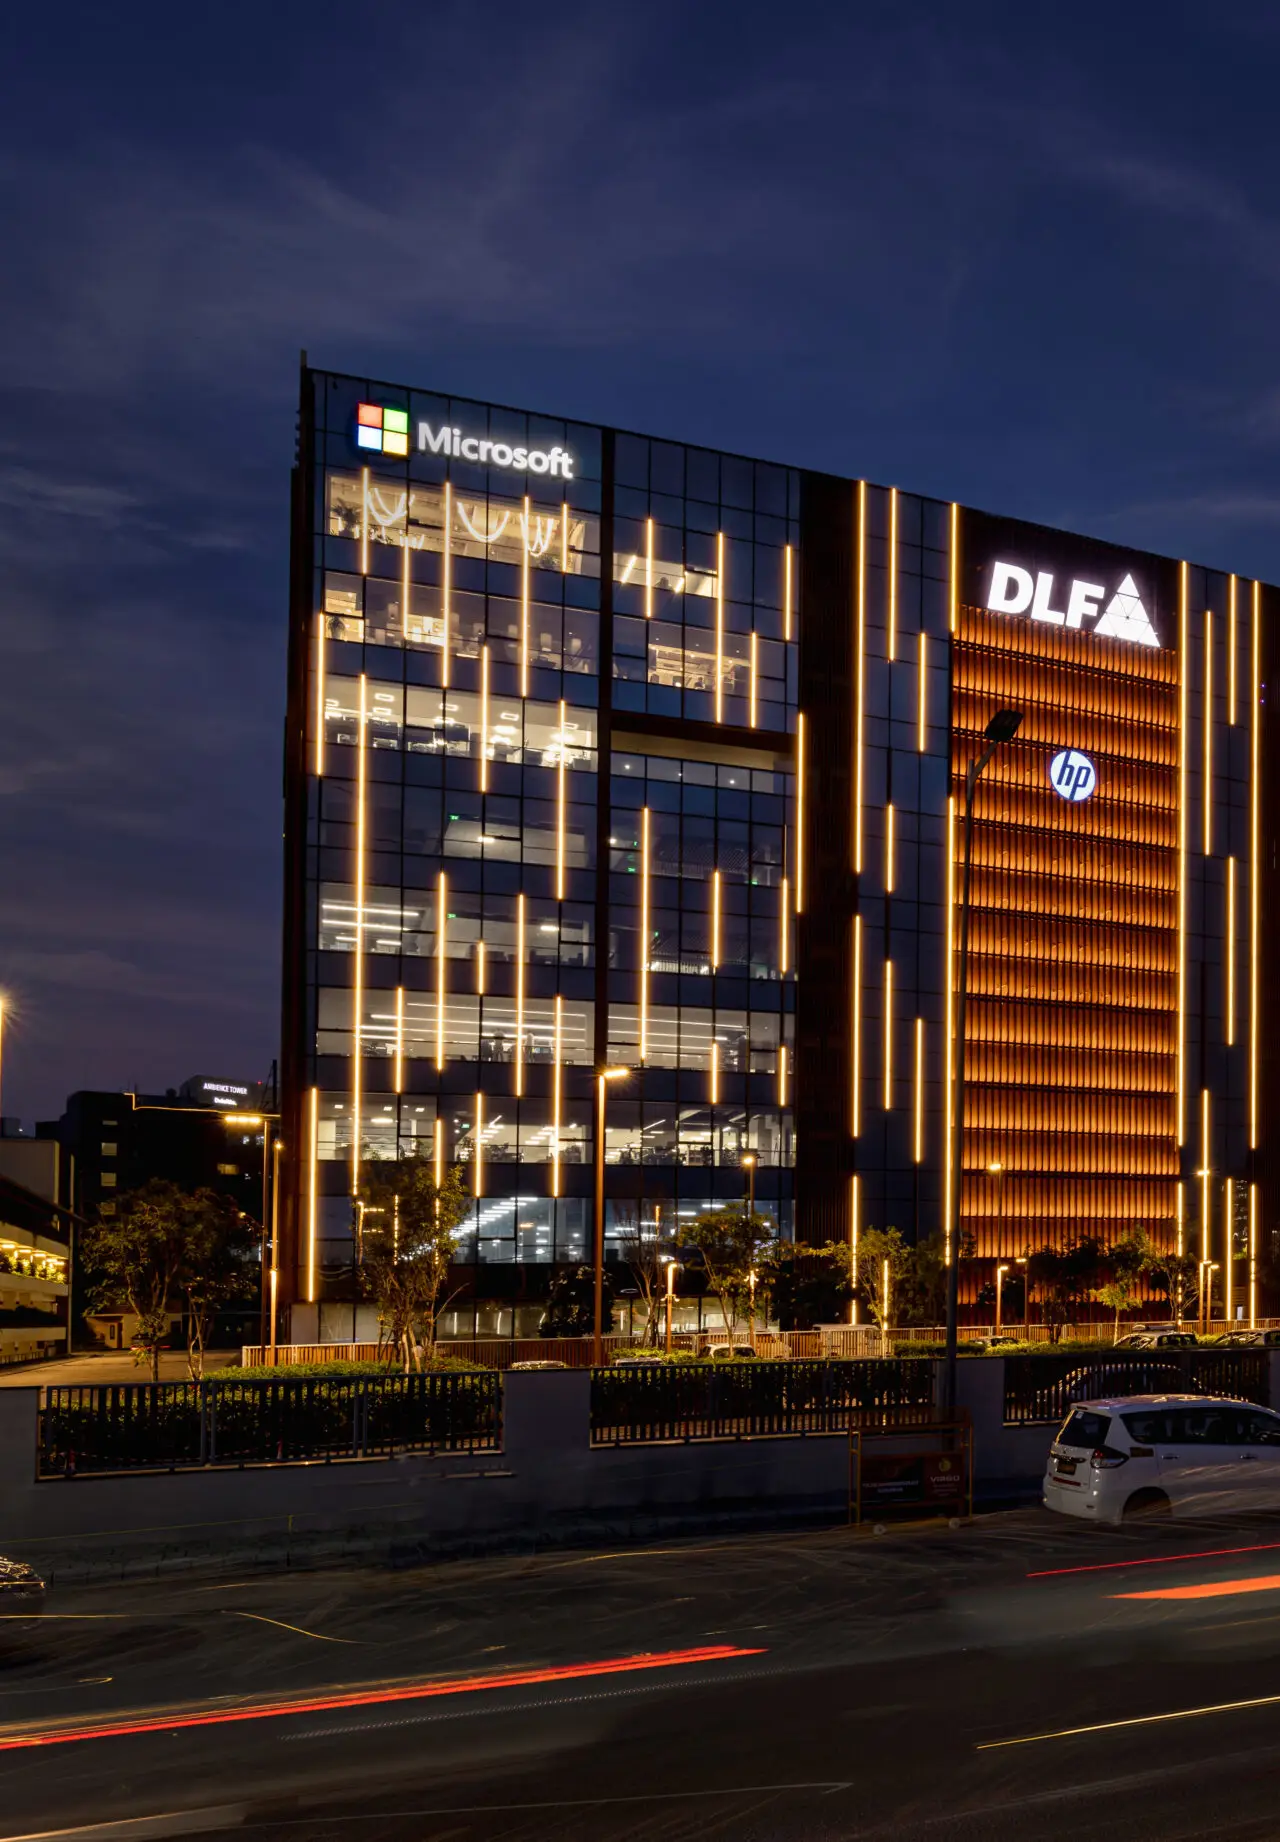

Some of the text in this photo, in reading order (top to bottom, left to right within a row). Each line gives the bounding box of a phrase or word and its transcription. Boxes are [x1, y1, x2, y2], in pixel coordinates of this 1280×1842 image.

[418, 422, 574, 479] Microsoft
[987, 561, 1105, 629] DLF
[1056, 750, 1091, 801] hp
[230, 1086, 248, 1095] TOWER
